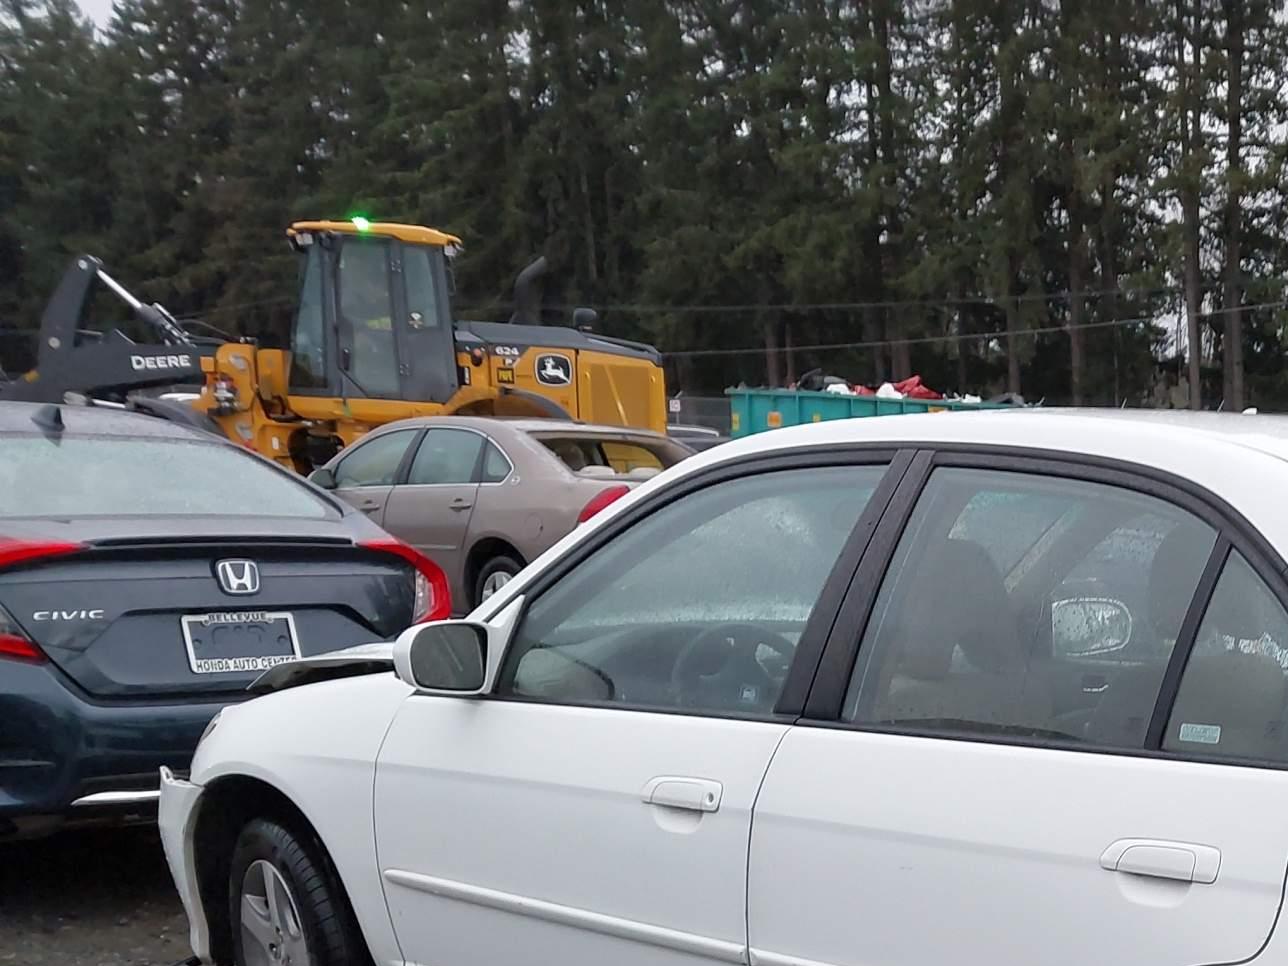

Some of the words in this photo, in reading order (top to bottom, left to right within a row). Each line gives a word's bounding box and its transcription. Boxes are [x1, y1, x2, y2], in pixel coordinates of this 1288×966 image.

[495, 346, 520, 356] 624
[130, 354, 191, 370] DEERE
[33, 609, 104, 621] CIVIC
[208, 612, 267, 622] BELLEVUE
[196, 659, 230, 672] HONDA
[233, 659, 258, 670] AUTO
